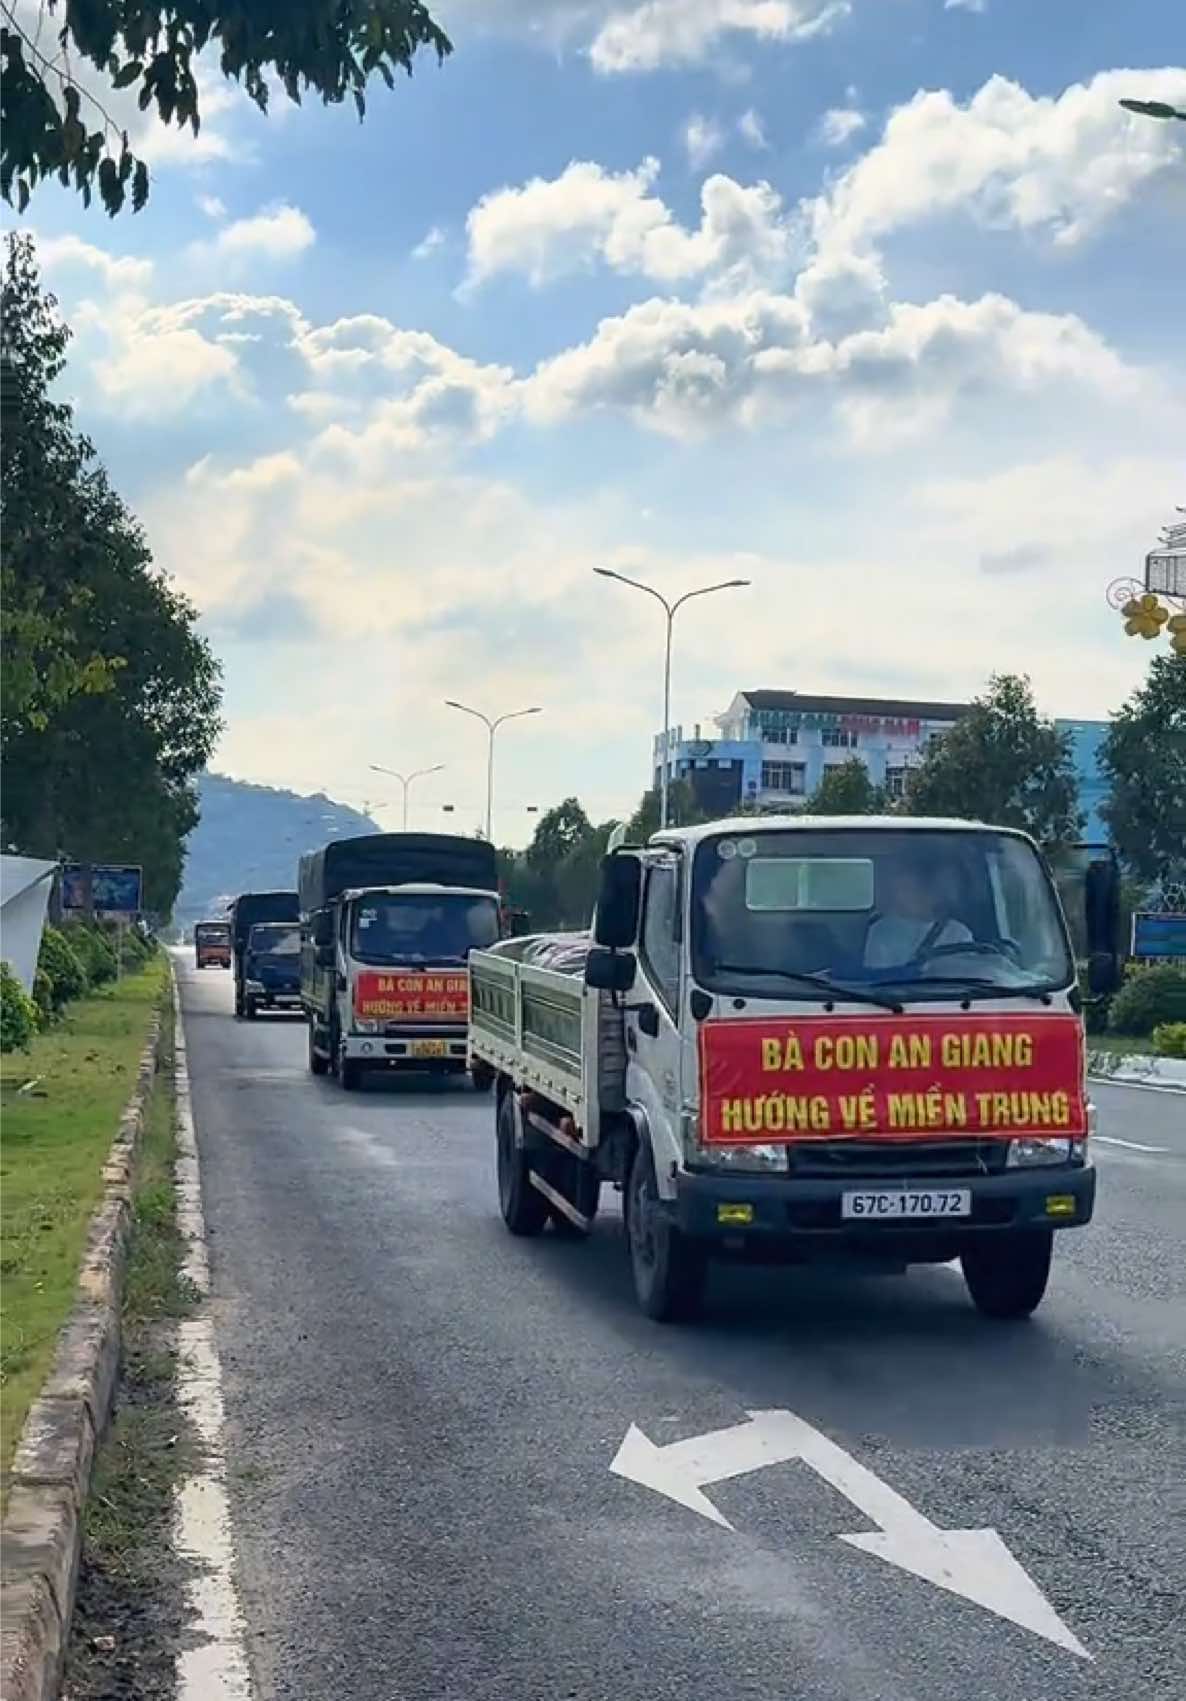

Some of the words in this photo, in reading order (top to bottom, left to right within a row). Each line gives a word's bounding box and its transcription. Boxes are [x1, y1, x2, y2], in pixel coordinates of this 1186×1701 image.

[762, 1030, 804, 1071] BÀ
[815, 1035, 878, 1070] CON
[888, 1034, 931, 1069] AN
[941, 1033, 1033, 1068] GIANG
[721, 1089, 831, 1131] HƯỚNG
[887, 1081, 967, 1127] MIỀN
[975, 1091, 1070, 1126] TRUNG
[852, 1193, 962, 1214] 67C-170.72
